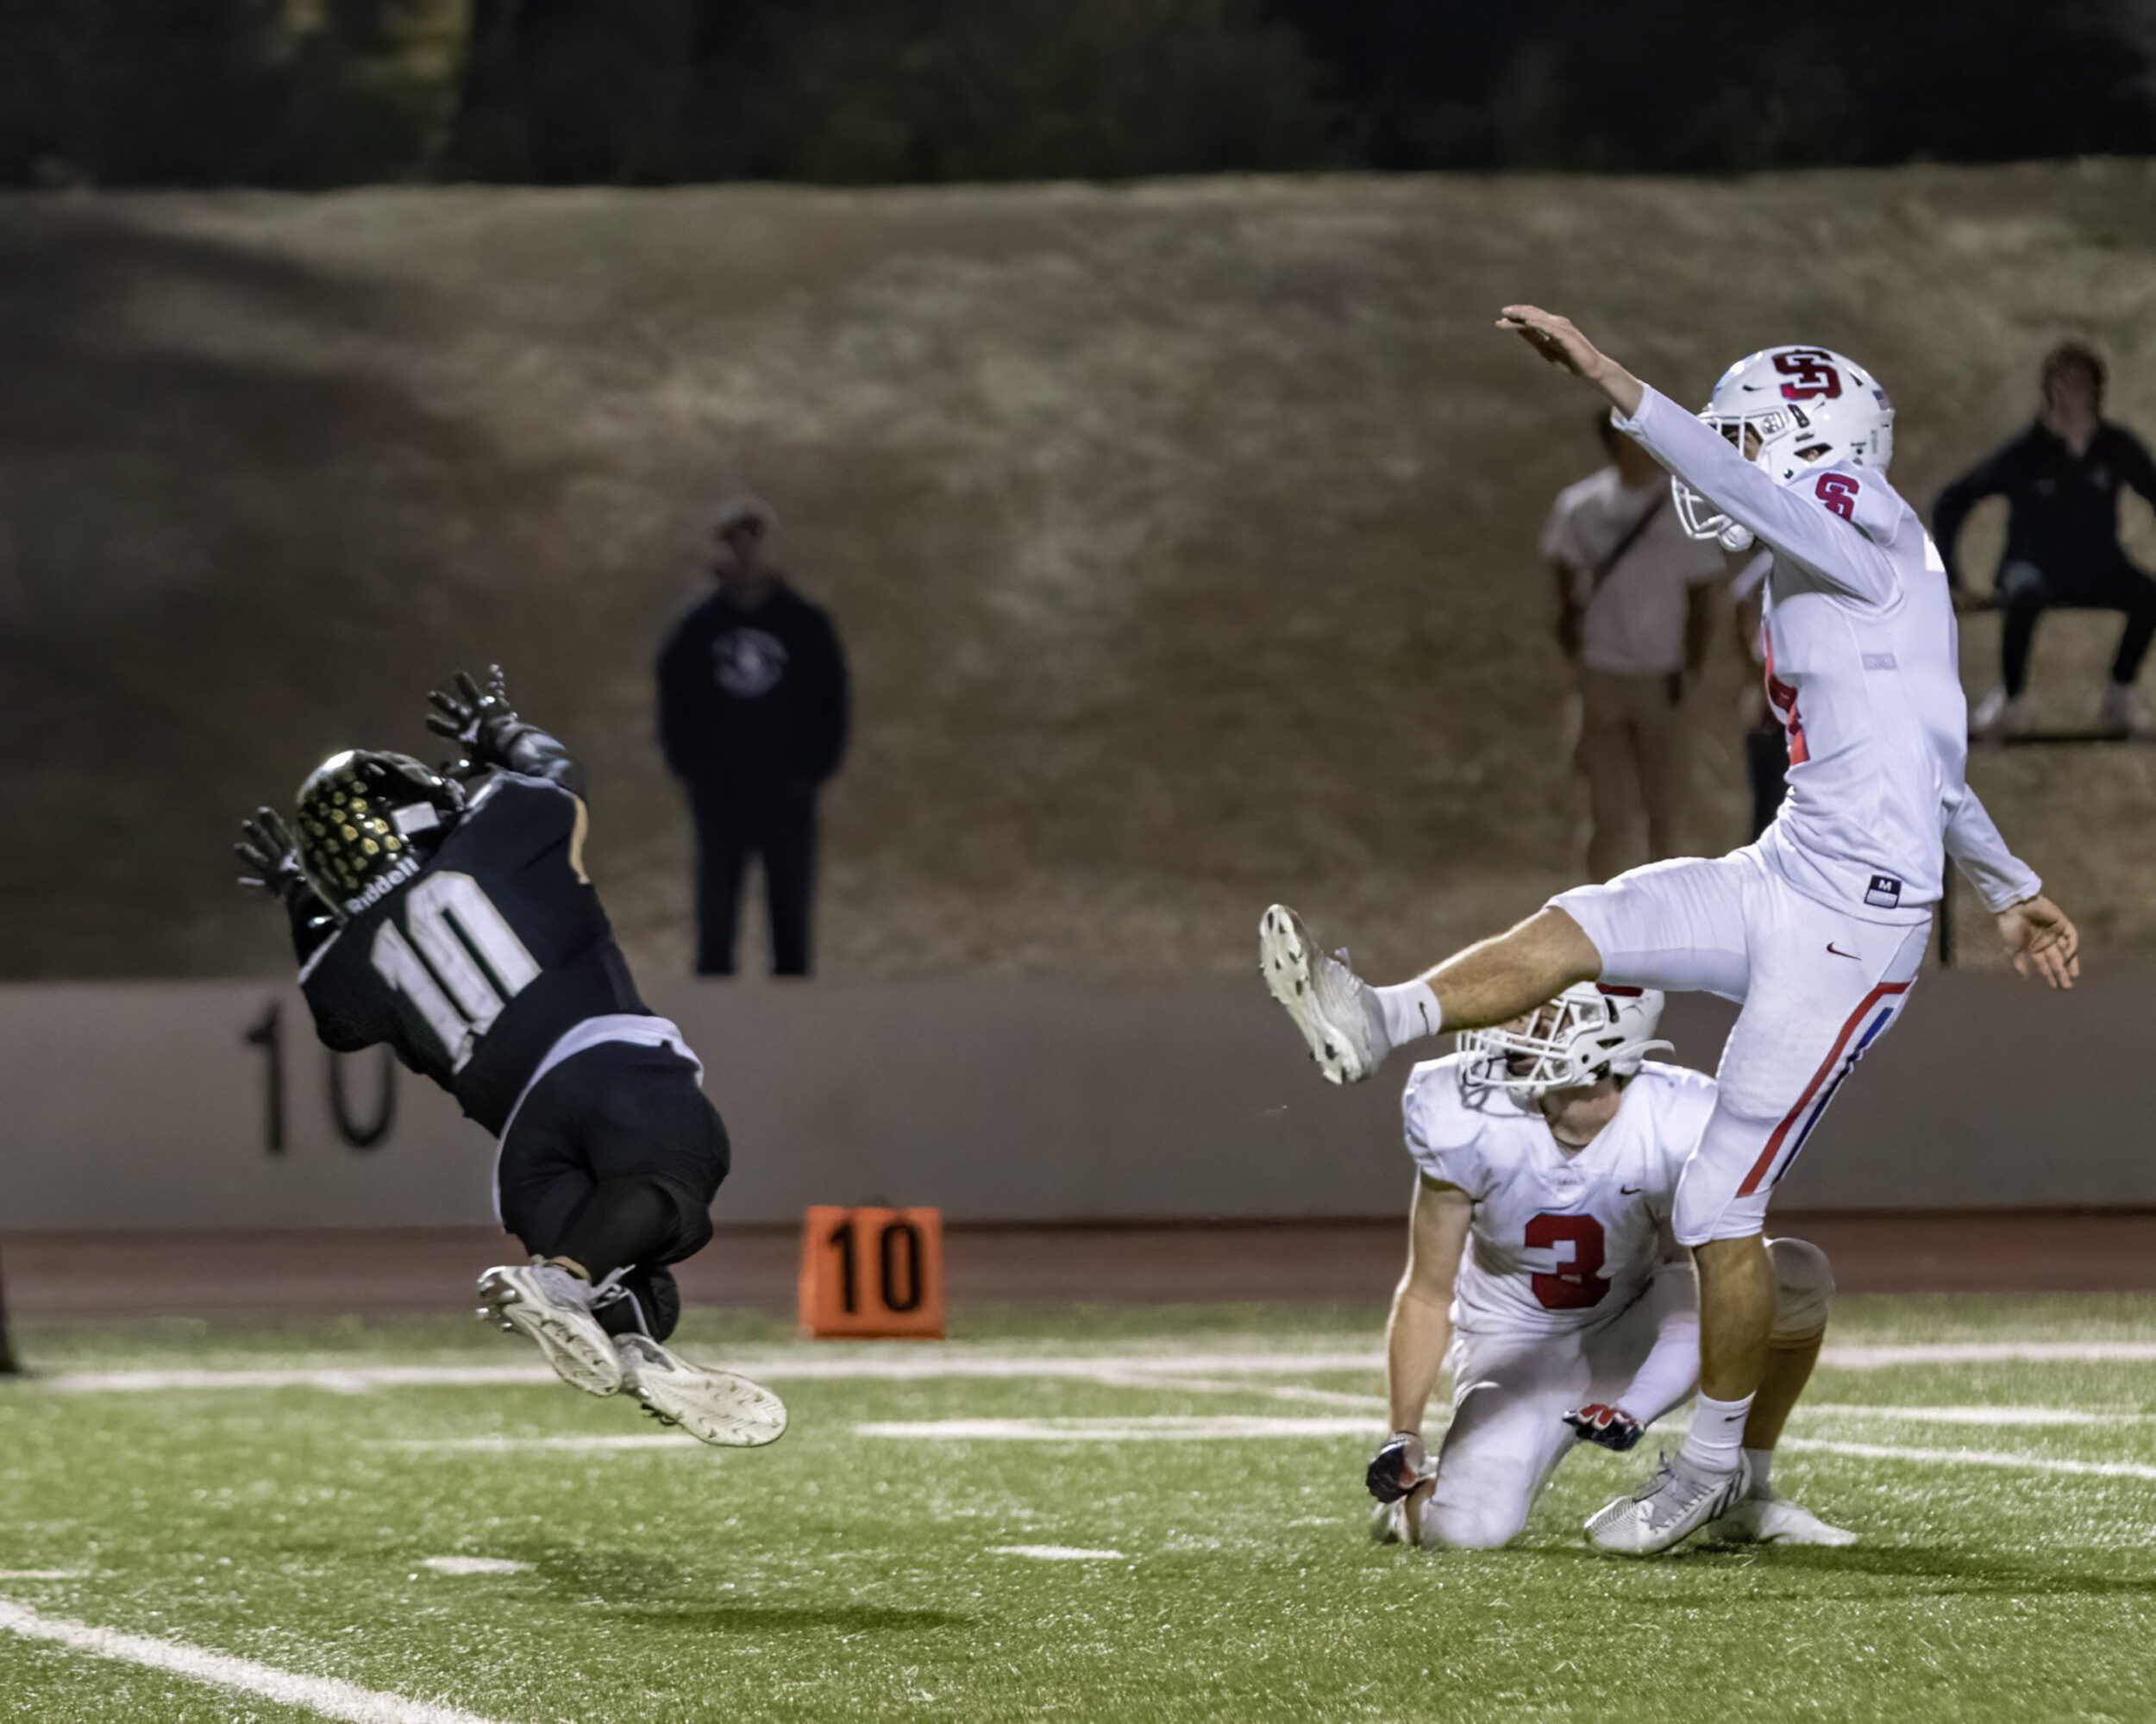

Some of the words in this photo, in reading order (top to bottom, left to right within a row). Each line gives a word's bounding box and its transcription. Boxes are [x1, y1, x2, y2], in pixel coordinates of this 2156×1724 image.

[346, 856, 420, 914] Riddell
[1878, 879, 1893, 892] M
[371, 870, 543, 1075] 10
[243, 1002, 398, 1154] 10
[828, 1221, 924, 1315] 10
[1524, 1212, 1611, 1310] 3
